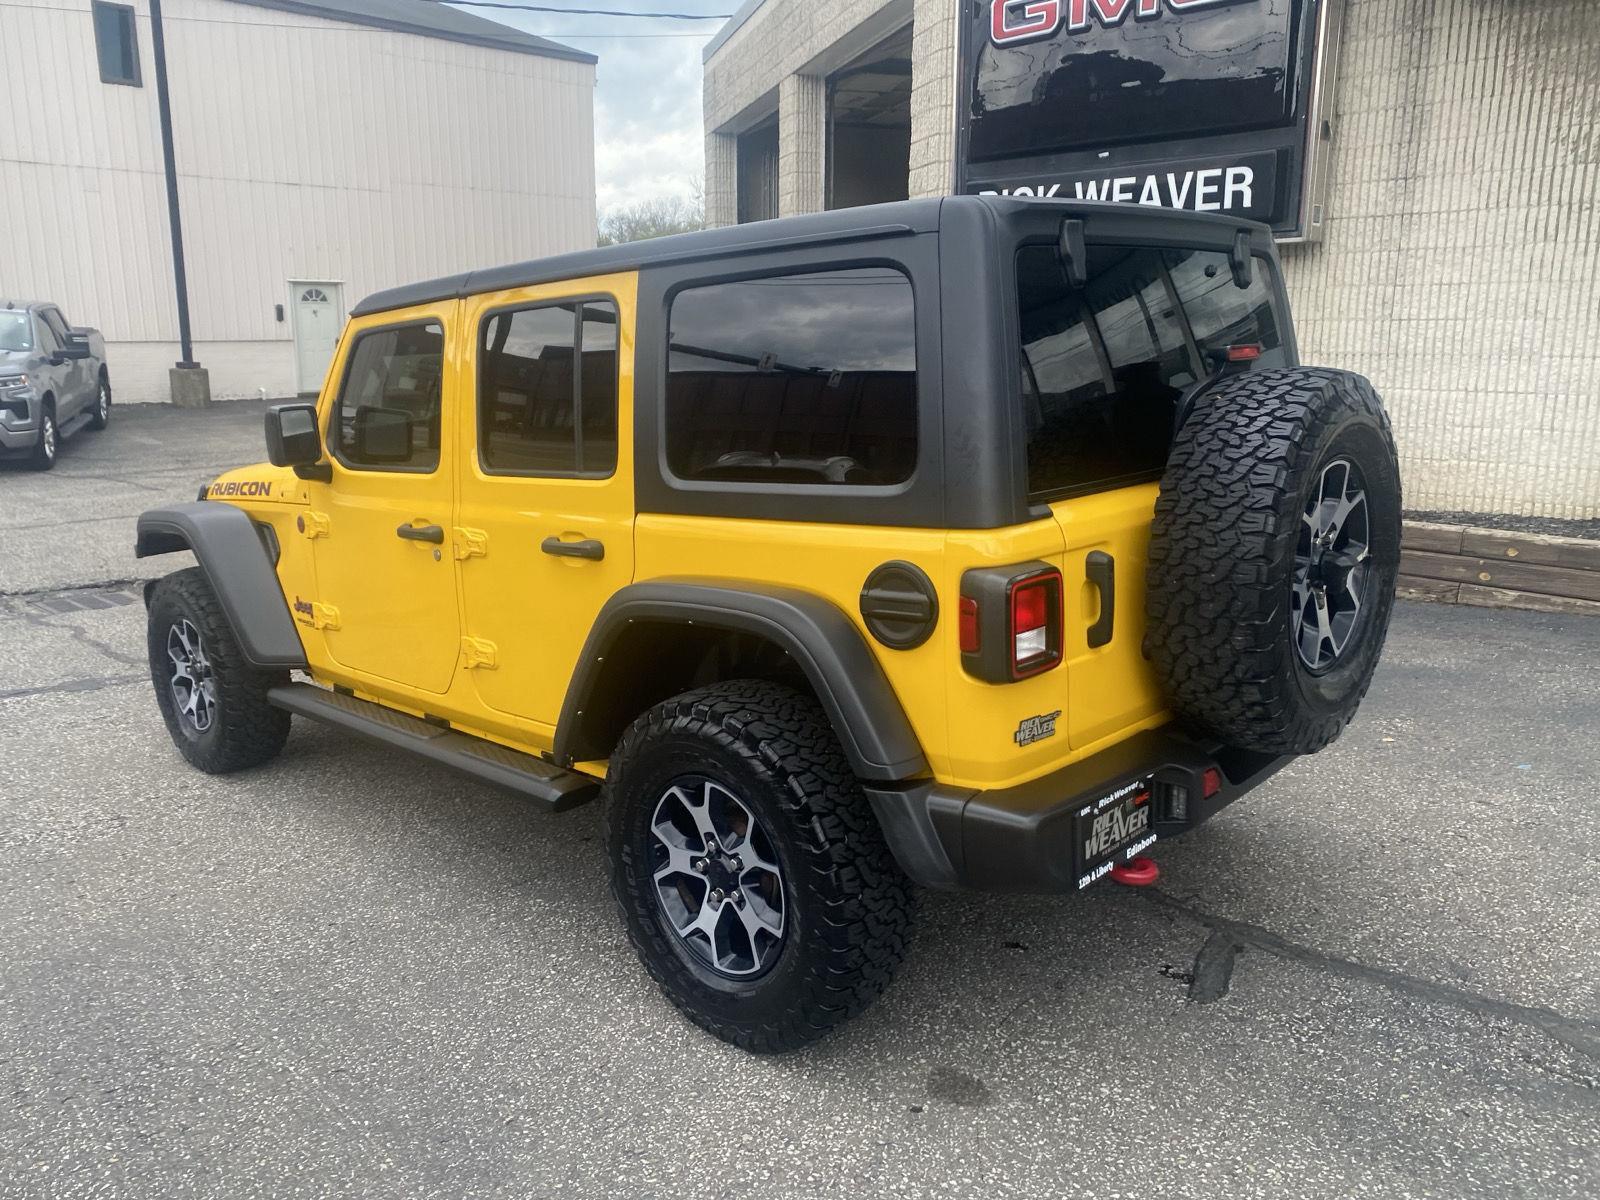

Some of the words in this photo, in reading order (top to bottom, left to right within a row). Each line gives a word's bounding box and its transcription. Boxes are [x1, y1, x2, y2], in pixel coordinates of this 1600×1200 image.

[991, 0, 1232, 44] GM
[210, 481, 272, 496] RUBICON
[1016, 719, 1056, 741] WEAVER
[1098, 793, 1115, 808] Rick
[1114, 781, 1139, 801] Weaver
[1085, 805, 1149, 860] WEAVER
[1092, 803, 1124, 836] RICK
[1126, 833, 1158, 859] Edinboro
[1078, 874, 1091, 890] 12th
[1096, 860, 1114, 877] Liberty
